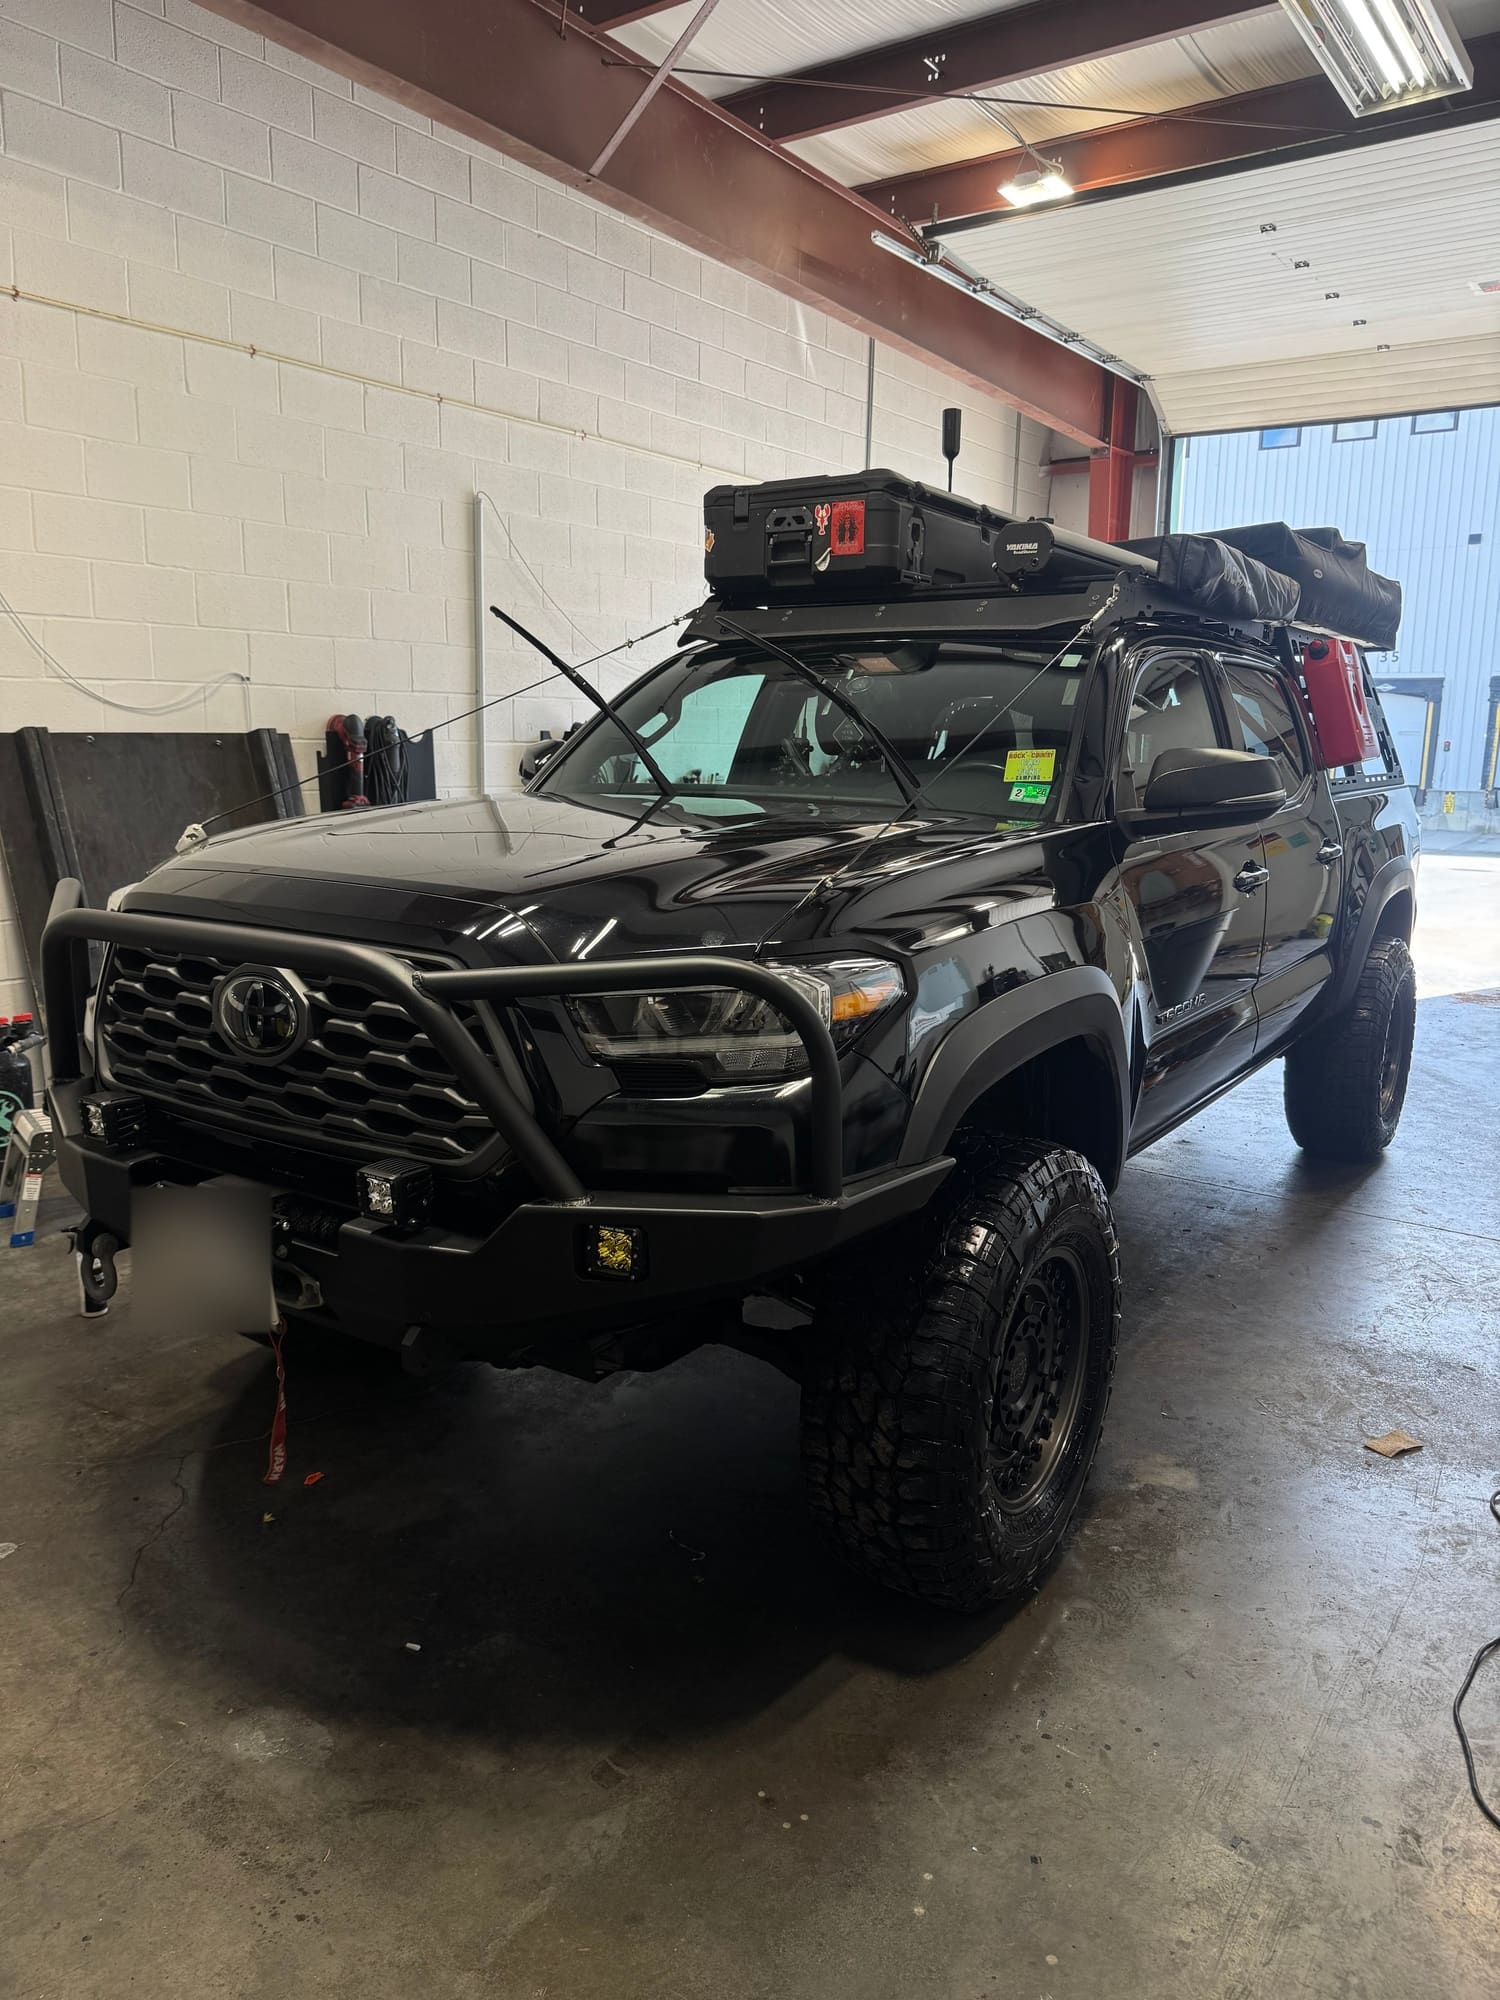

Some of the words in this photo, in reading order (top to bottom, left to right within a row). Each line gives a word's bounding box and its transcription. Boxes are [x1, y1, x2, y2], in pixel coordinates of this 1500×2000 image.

[1006, 543, 1038, 551] YAKIMA
[1380, 651, 1400, 663] 35
[1015, 788, 1023, 798] 2
[1155, 992, 1206, 1024] TACOMA
[268, 1443, 285, 1480] WARN
